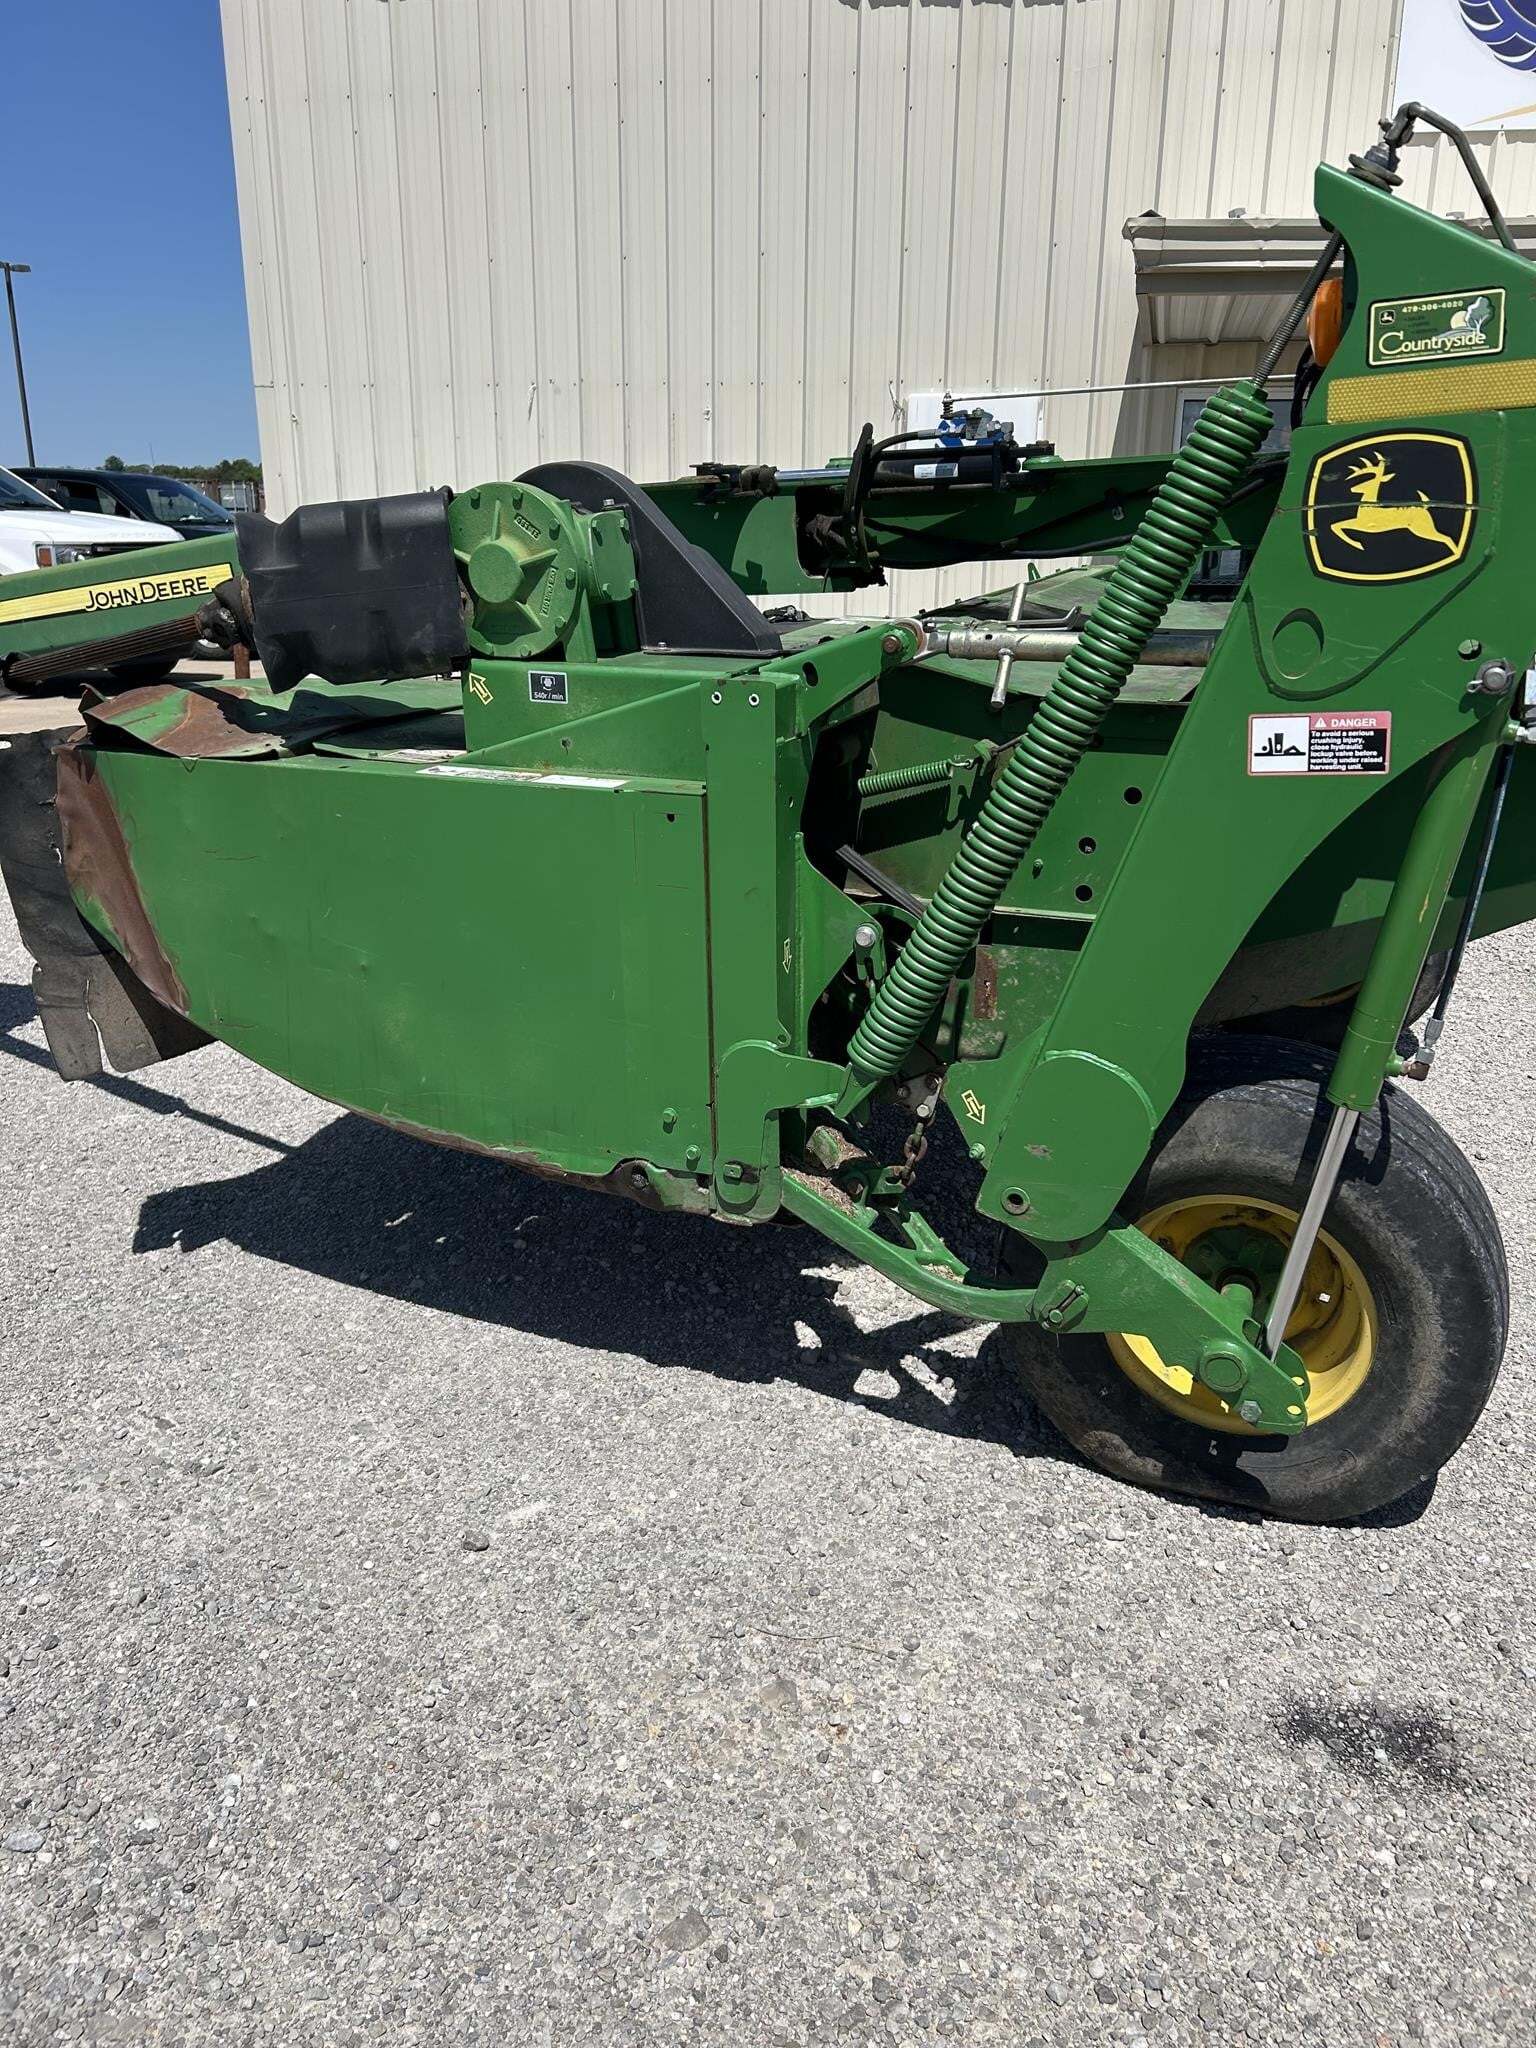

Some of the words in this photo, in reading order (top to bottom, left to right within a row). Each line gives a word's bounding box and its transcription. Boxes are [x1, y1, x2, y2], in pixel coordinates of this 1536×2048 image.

[1378, 330, 1486, 354] Countryside
[86, 587, 138, 609] JOHN
[140, 576, 209, 600] DEERE
[1331, 718, 1376, 728] DANGER
[1330, 743, 1363, 751] hydraulic
[1310, 757, 1338, 765] working
